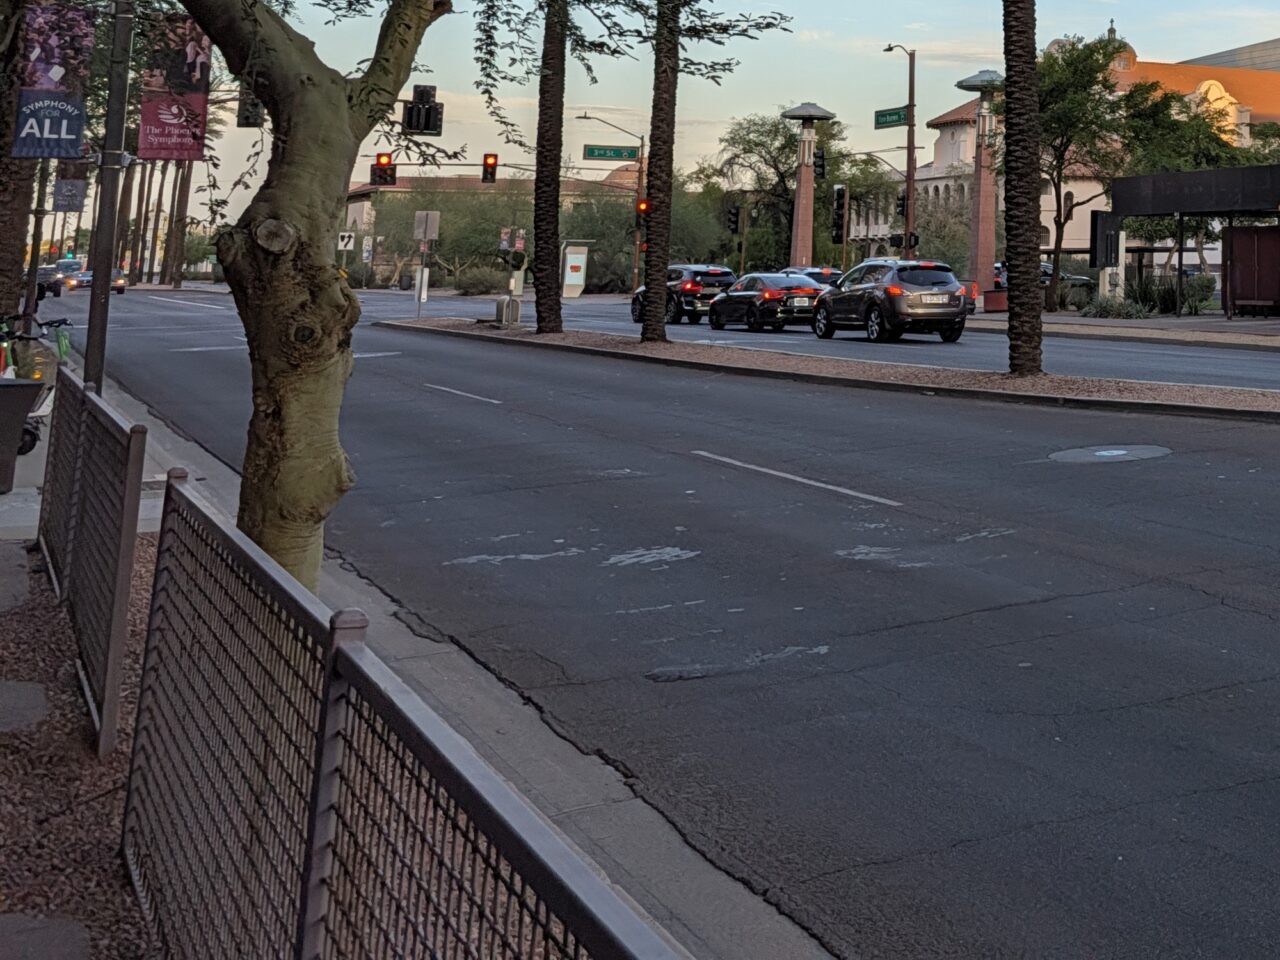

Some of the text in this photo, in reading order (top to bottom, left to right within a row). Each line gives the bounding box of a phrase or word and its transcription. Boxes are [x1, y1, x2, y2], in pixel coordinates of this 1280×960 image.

[22, 100, 80, 116] SYMPHONY
[41, 109, 60, 118] FOR
[20, 118, 76, 139] ALL
[144, 126, 163, 134] The
[148, 135, 194, 145] Symphony
